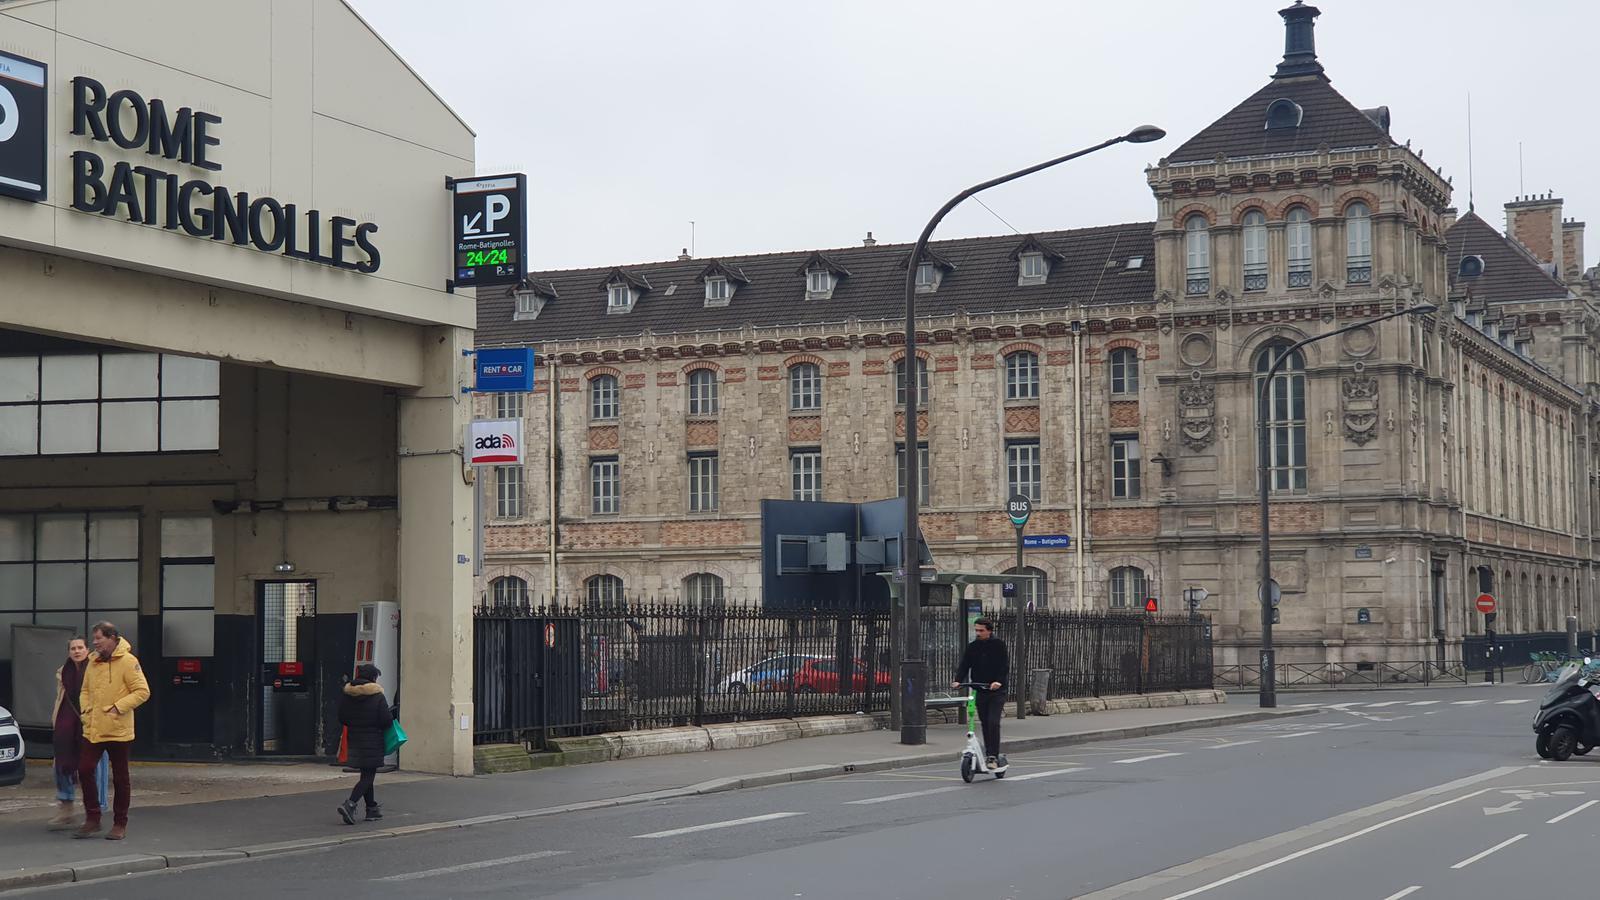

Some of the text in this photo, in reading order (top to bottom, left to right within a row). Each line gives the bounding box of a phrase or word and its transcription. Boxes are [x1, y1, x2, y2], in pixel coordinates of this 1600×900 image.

[73, 76, 222, 171] ROME
[73, 151, 381, 274] BATIGNOLLES
[486, 194, 511, 232] P
[458, 240, 515, 250] Rome-Batignolles
[467, 249, 507, 267] 24/24
[483, 366, 501, 374] RENT
[507, 365, 522, 373] CAR
[475, 434, 501, 449] ada
[1010, 501, 1028, 511] BUS
[1041, 538, 1067, 546] Batignolles
